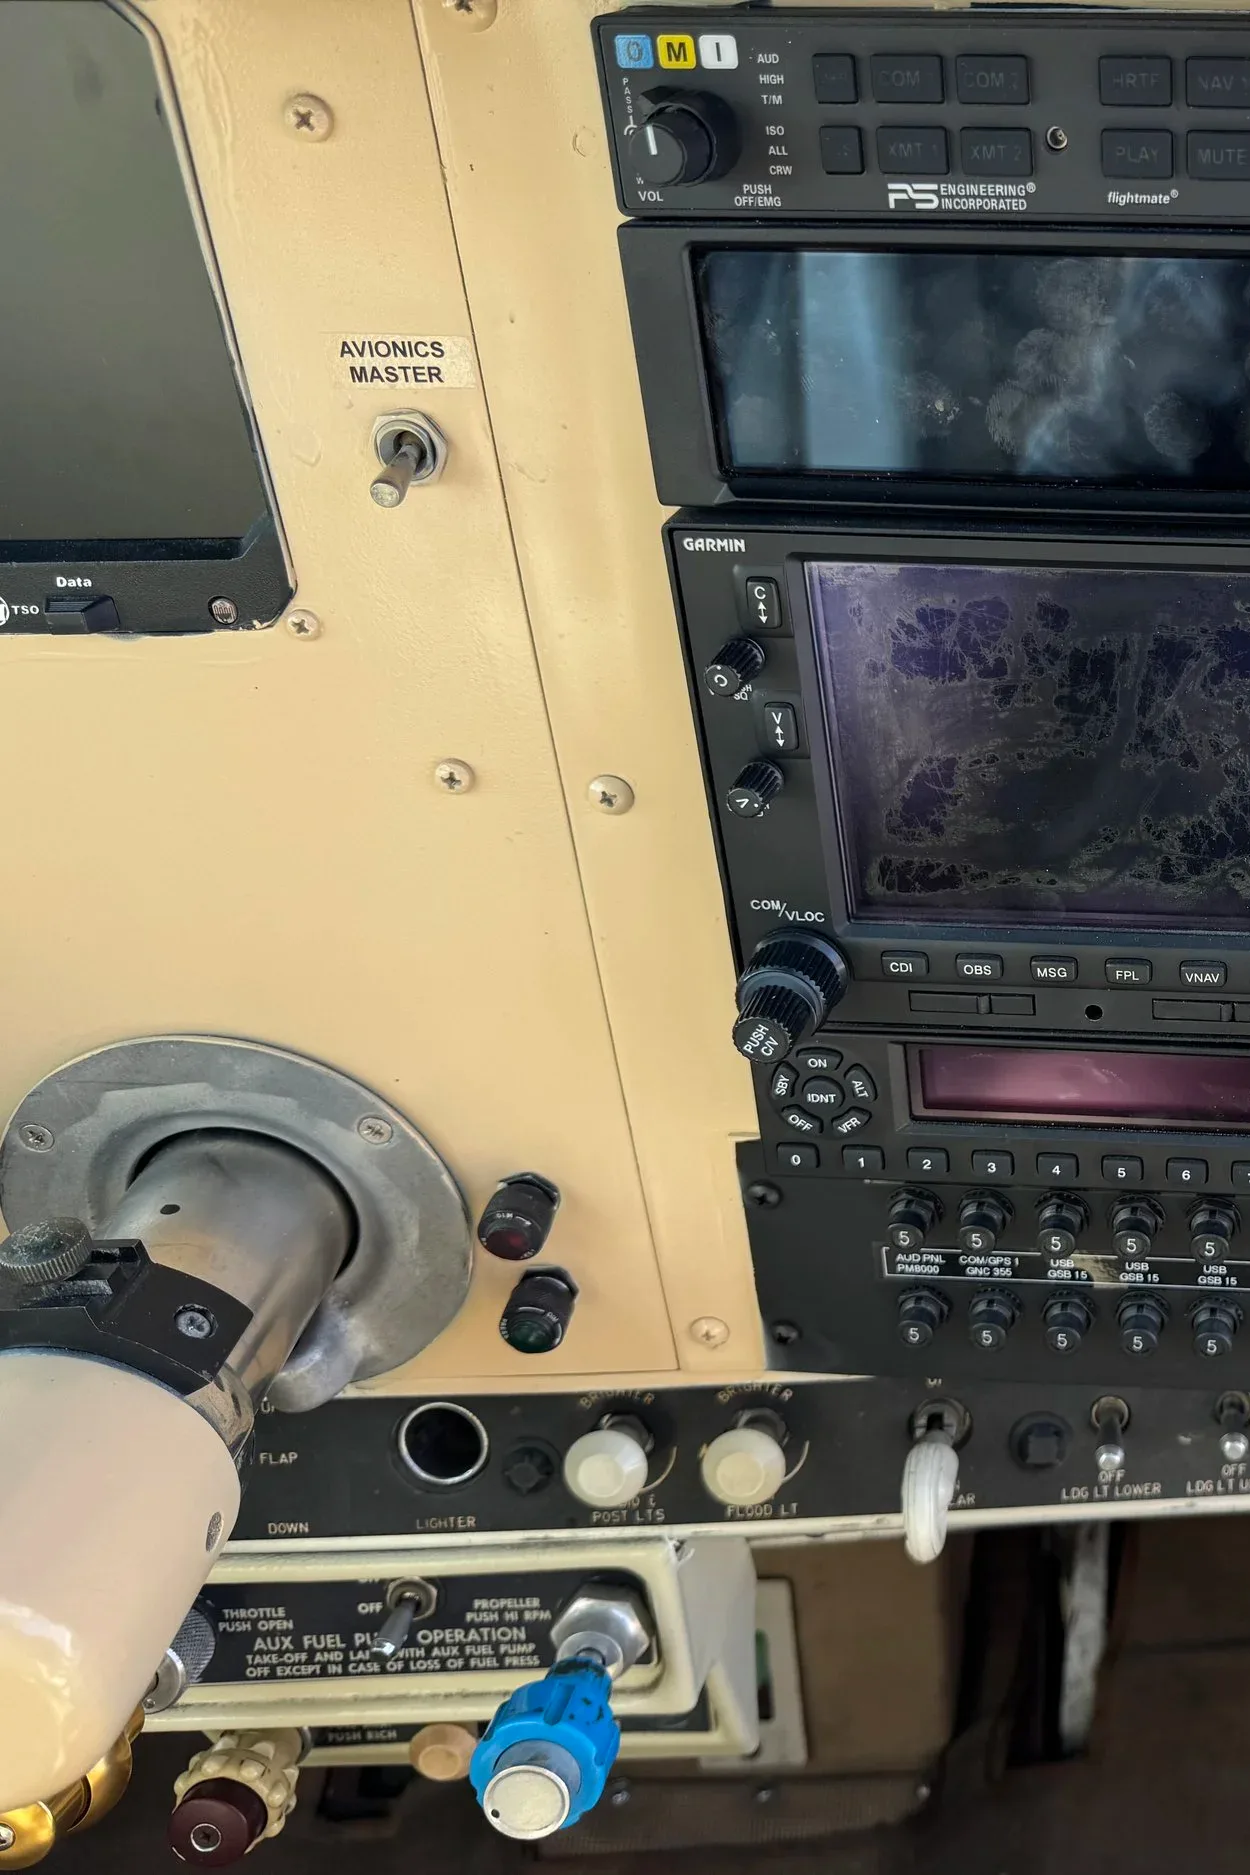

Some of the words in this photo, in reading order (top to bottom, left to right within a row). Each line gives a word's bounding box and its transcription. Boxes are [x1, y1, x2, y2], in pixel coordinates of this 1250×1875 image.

[757, 54, 779, 64] AUD
[759, 75, 784, 84] HIGH
[761, 95, 783, 105] T/M
[766, 126, 785, 136] ISO
[768, 146, 788, 156] ALL
[769, 166, 792, 176] CRW
[743, 184, 773, 195] PUSH
[638, 191, 664, 202] VOL
[734, 196, 782, 207] OFF/EMG
[941, 198, 1028, 211] INCORPORATED
[340, 340, 445, 358] AVIONICS
[350, 366, 445, 383] MASTER
[683, 538, 746, 552] GARMIN
[56, 577, 92, 588] Data
[11, 606, 40, 615] TSO
[889, 962, 913, 973] CDI
[963, 964, 992, 976] OBS
[1037, 967, 1067, 978] MSG
[1115, 970, 1139, 981] FPL
[1185, 972, 1220, 984] VNAV
[743, 1024, 769, 1054] PUSH
[808, 1058, 827, 1068] ON
[775, 1075, 790, 1096] SBY
[852, 1080, 868, 1099] ALT
[807, 1093, 836, 1104] IDNT
[788, 1114, 813, 1132] OFF
[838, 1116, 861, 1134] VFR
[896, 1253, 921, 1263] AUD
[922, 1254, 946, 1264] PNL
[959, 1255, 1012, 1267] COM/GPS
[1050, 1259, 1074, 1268] USB
[966, 1266, 991, 1276] GNC
[993, 1267, 1012, 1277] 355
[1125, 1262, 1149, 1272] USB
[1203, 1265, 1227, 1275] USB
[1048, 1270, 1072, 1279] GSB
[1075, 1270, 1088, 1280] 15
[1120, 1272, 1145, 1282] GSB
[1147, 1273, 1159, 1283] 15
[1198, 1275, 1223, 1285] GSB
[1225, 1276, 1237, 1286] 15
[259, 1452, 298, 1465] FLAP
[1221, 1463, 1247, 1477] OFF
[1098, 1469, 1125, 1484] OFF
[1061, 1487, 1089, 1500] LDG
[1094, 1485, 1109, 1498] LT
[1114, 1482, 1162, 1496] LOWER
[1186, 1480, 1213, 1494] LDG
[1217, 1479, 1235, 1492] LT
[592, 1510, 628, 1523] POST
[635, 1509, 665, 1522] LTS
[727, 1503, 773, 1518] FLOOD
[780, 1502, 798, 1515] LT
[268, 1522, 309, 1534] DOWN
[416, 1516, 476, 1530] LIGHTER
[357, 1602, 383, 1615] OFF
[473, 1597, 541, 1610] PROPELLER
[222, 1606, 286, 1619] THROTTLE
[465, 1611, 499, 1623] PUSH
[505, 1610, 518, 1621] HI
[524, 1609, 551, 1620] RPM
[218, 1621, 252, 1633] PUSH
[257, 1619, 294, 1632] OPEN
[254, 1635, 295, 1652] AUX
[302, 1634, 347, 1650] FUEL
[417, 1626, 526, 1644] OPERATION
[246, 1651, 309, 1666] TAKE-OFF
[314, 1651, 344, 1663] AND
[431, 1646, 460, 1657] AUX
[465, 1645, 495, 1656] FUEL
[500, 1643, 536, 1654] PUMP
[246, 1666, 270, 1678] OFF
[276, 1664, 322, 1677] EXCEPT
[328, 1663, 342, 1674] IN
[348, 1661, 381, 1674] CASE
[386, 1660, 404, 1672] OF
[410, 1658, 441, 1671] LOSS
[447, 1657, 465, 1669] OF
[470, 1656, 500, 1668] FUEL
[505, 1655, 541, 1667] PRESS
[328, 1730, 363, 1743] PUSH
[366, 1728, 397, 1741] RICH
